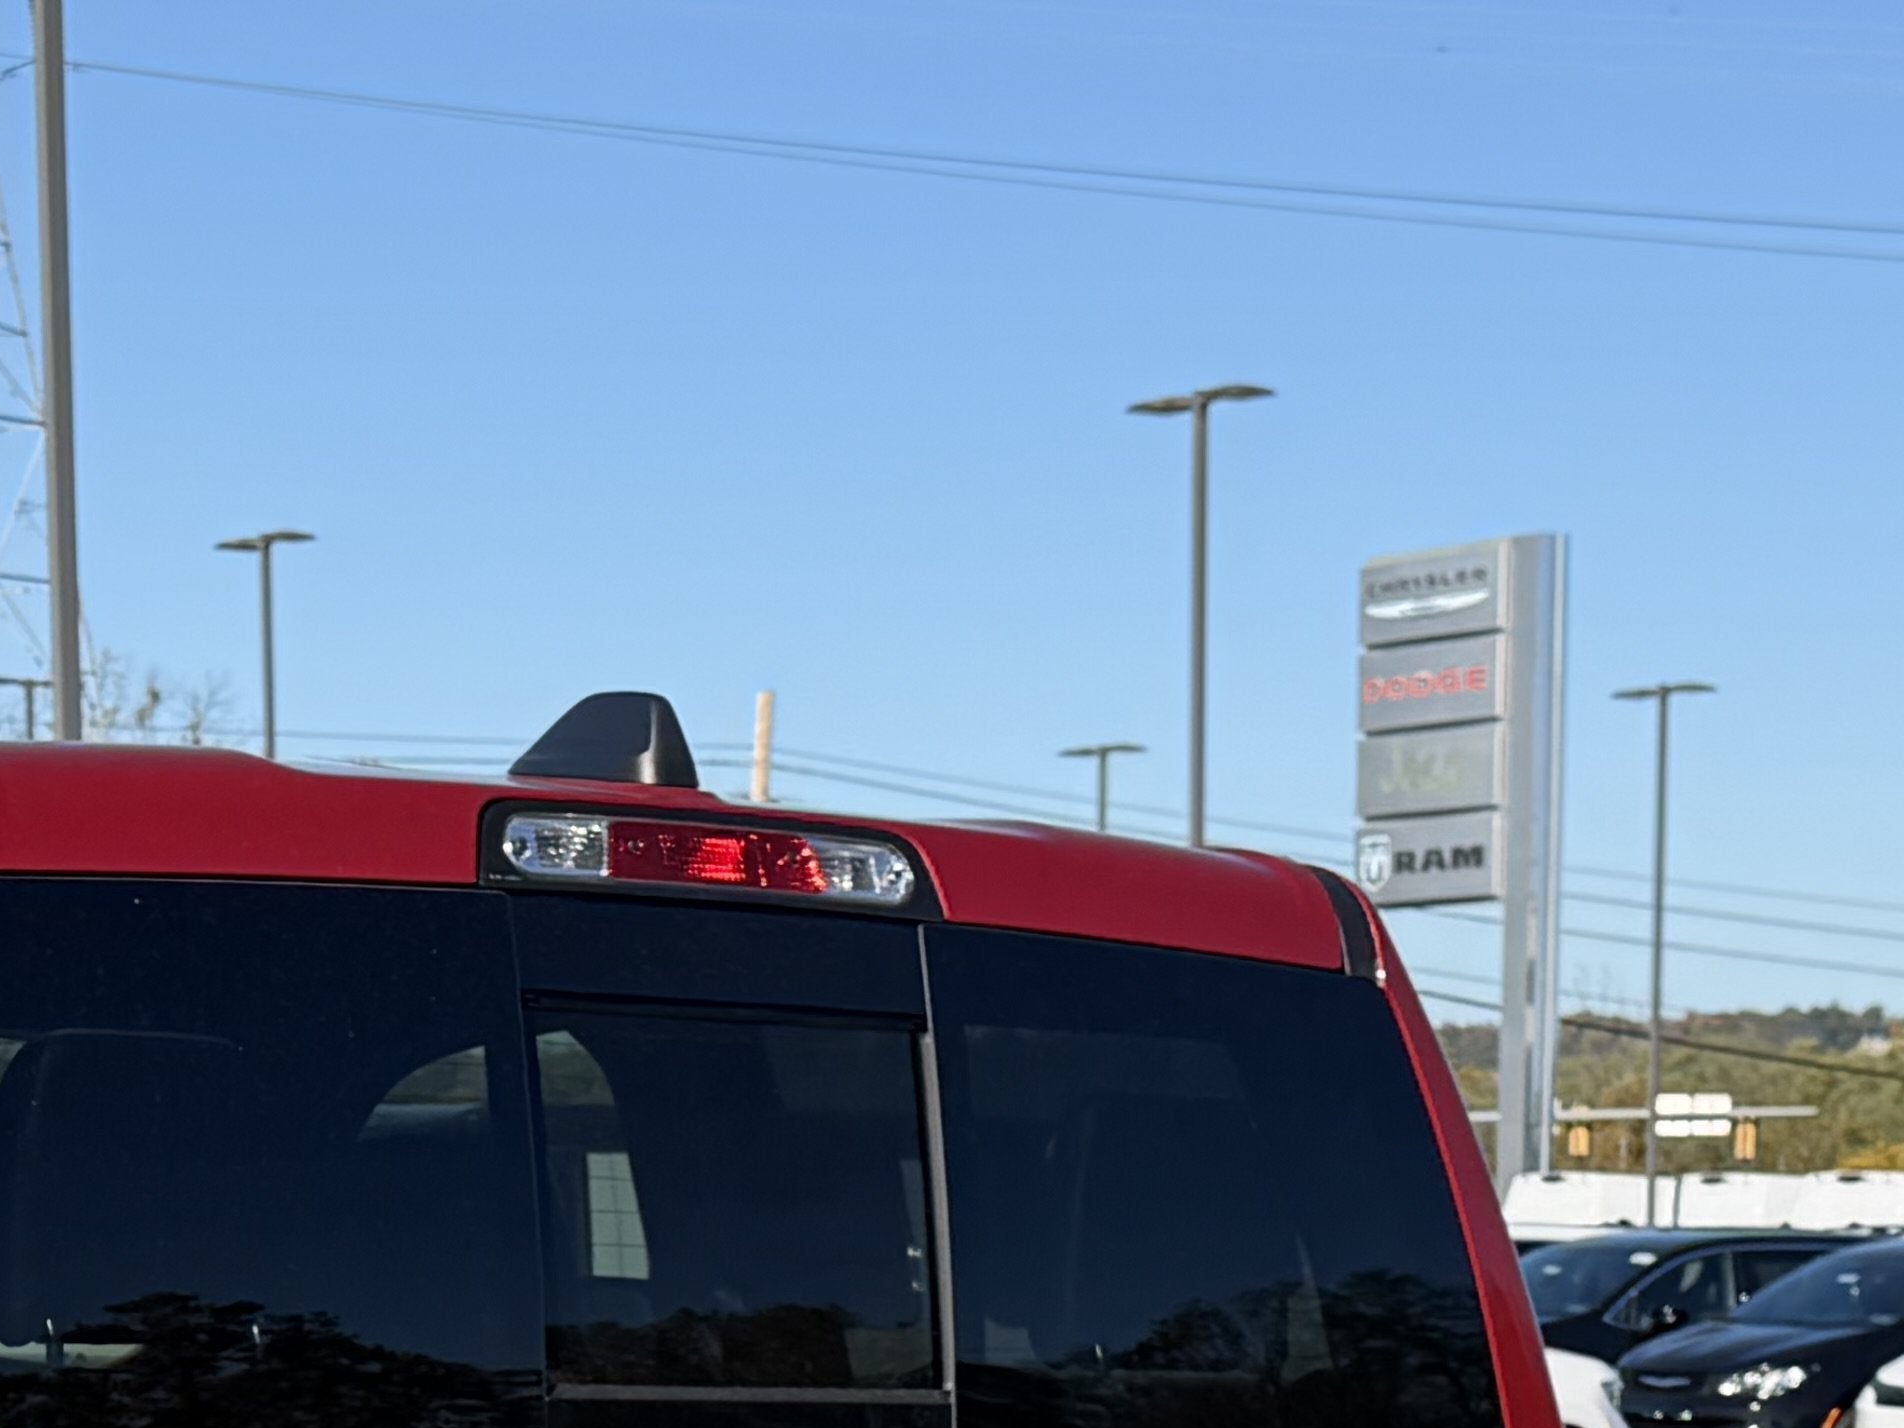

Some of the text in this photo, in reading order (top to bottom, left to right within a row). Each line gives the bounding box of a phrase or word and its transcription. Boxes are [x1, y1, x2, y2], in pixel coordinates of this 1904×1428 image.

[1365, 566, 1488, 600] CHRYSLER
[1362, 665, 1489, 704] DODGE
[1395, 844, 1484, 875] RAM
